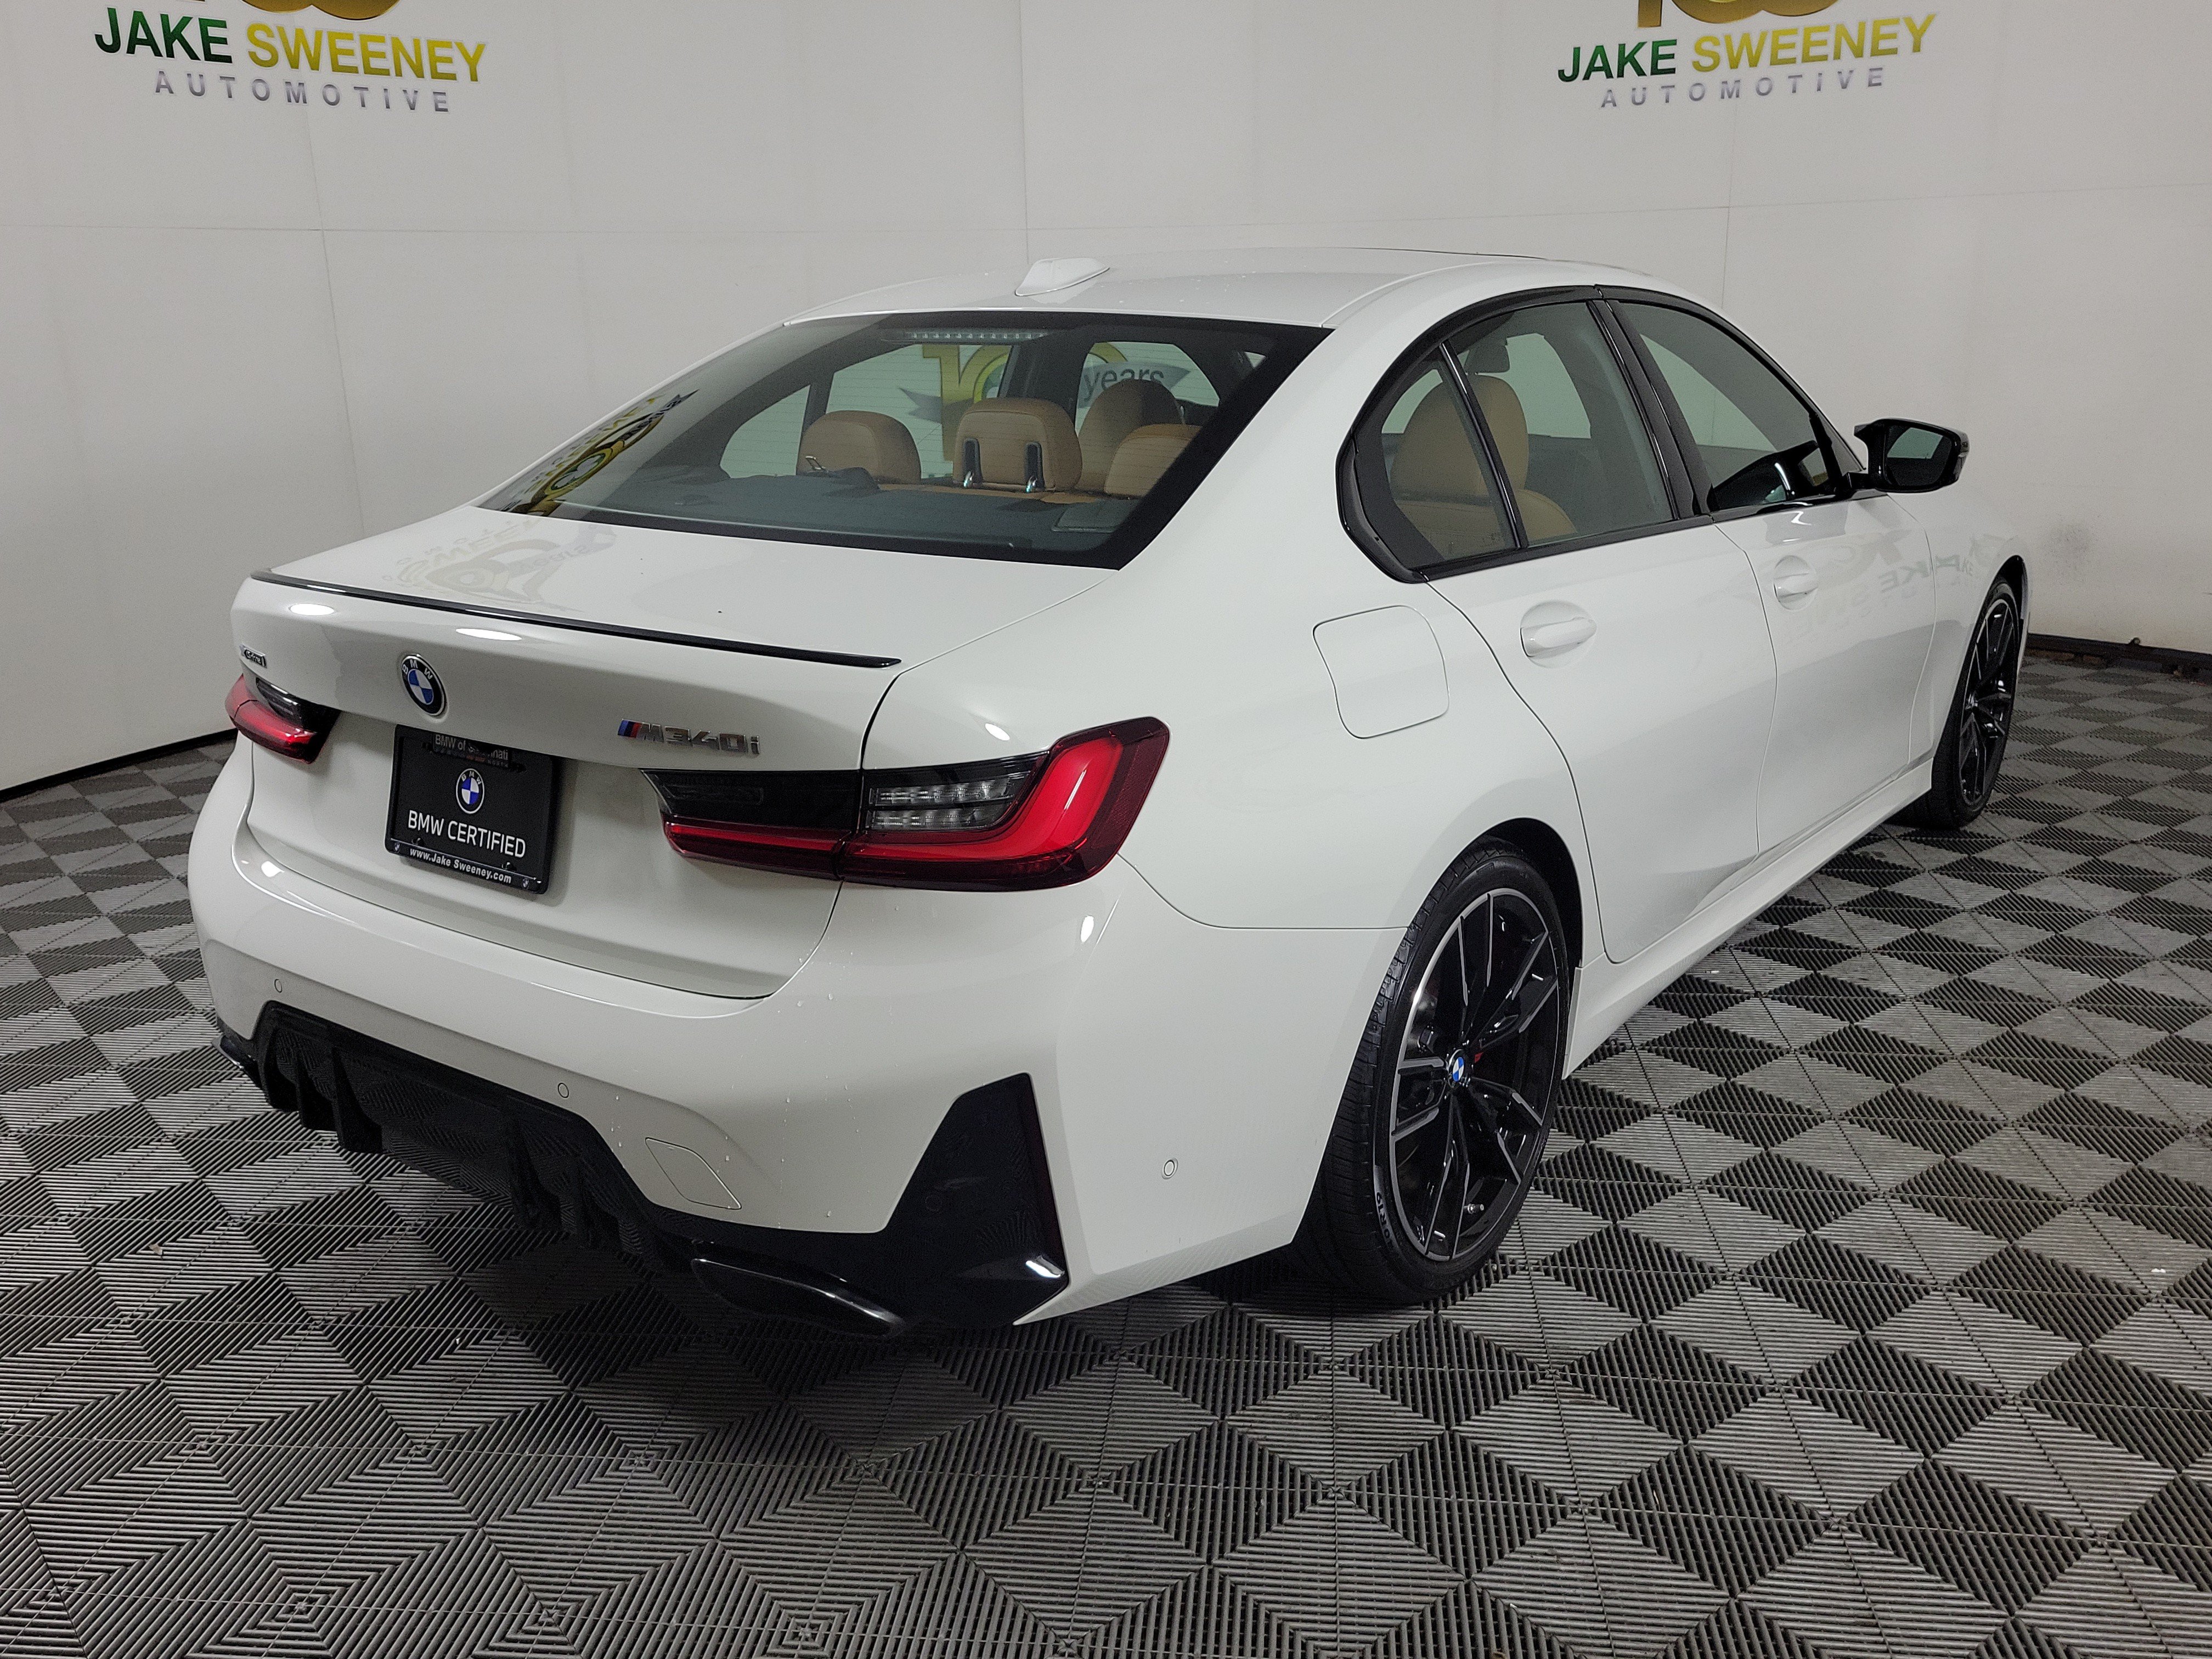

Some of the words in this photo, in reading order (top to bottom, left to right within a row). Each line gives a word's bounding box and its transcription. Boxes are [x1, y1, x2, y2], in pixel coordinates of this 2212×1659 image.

[94, 8, 233, 64] JAKE
[247, 22, 486, 82] SWEENEY
[1558, 39, 1678, 83] JAKE
[1691, 14, 1936, 72] SWEENEY
[155, 70, 449, 113] AUTOMOTIVE
[1600, 67, 1884, 109] AUTOMOTIVE
[402, 659, 433, 680] BMW
[435, 734, 455, 749] BMW
[408, 810, 445, 836] BMW
[448, 820, 526, 858] CERTIFIED
[410, 848, 451, 866] www.Jake
[453, 859, 512, 884] Sweeney.com
